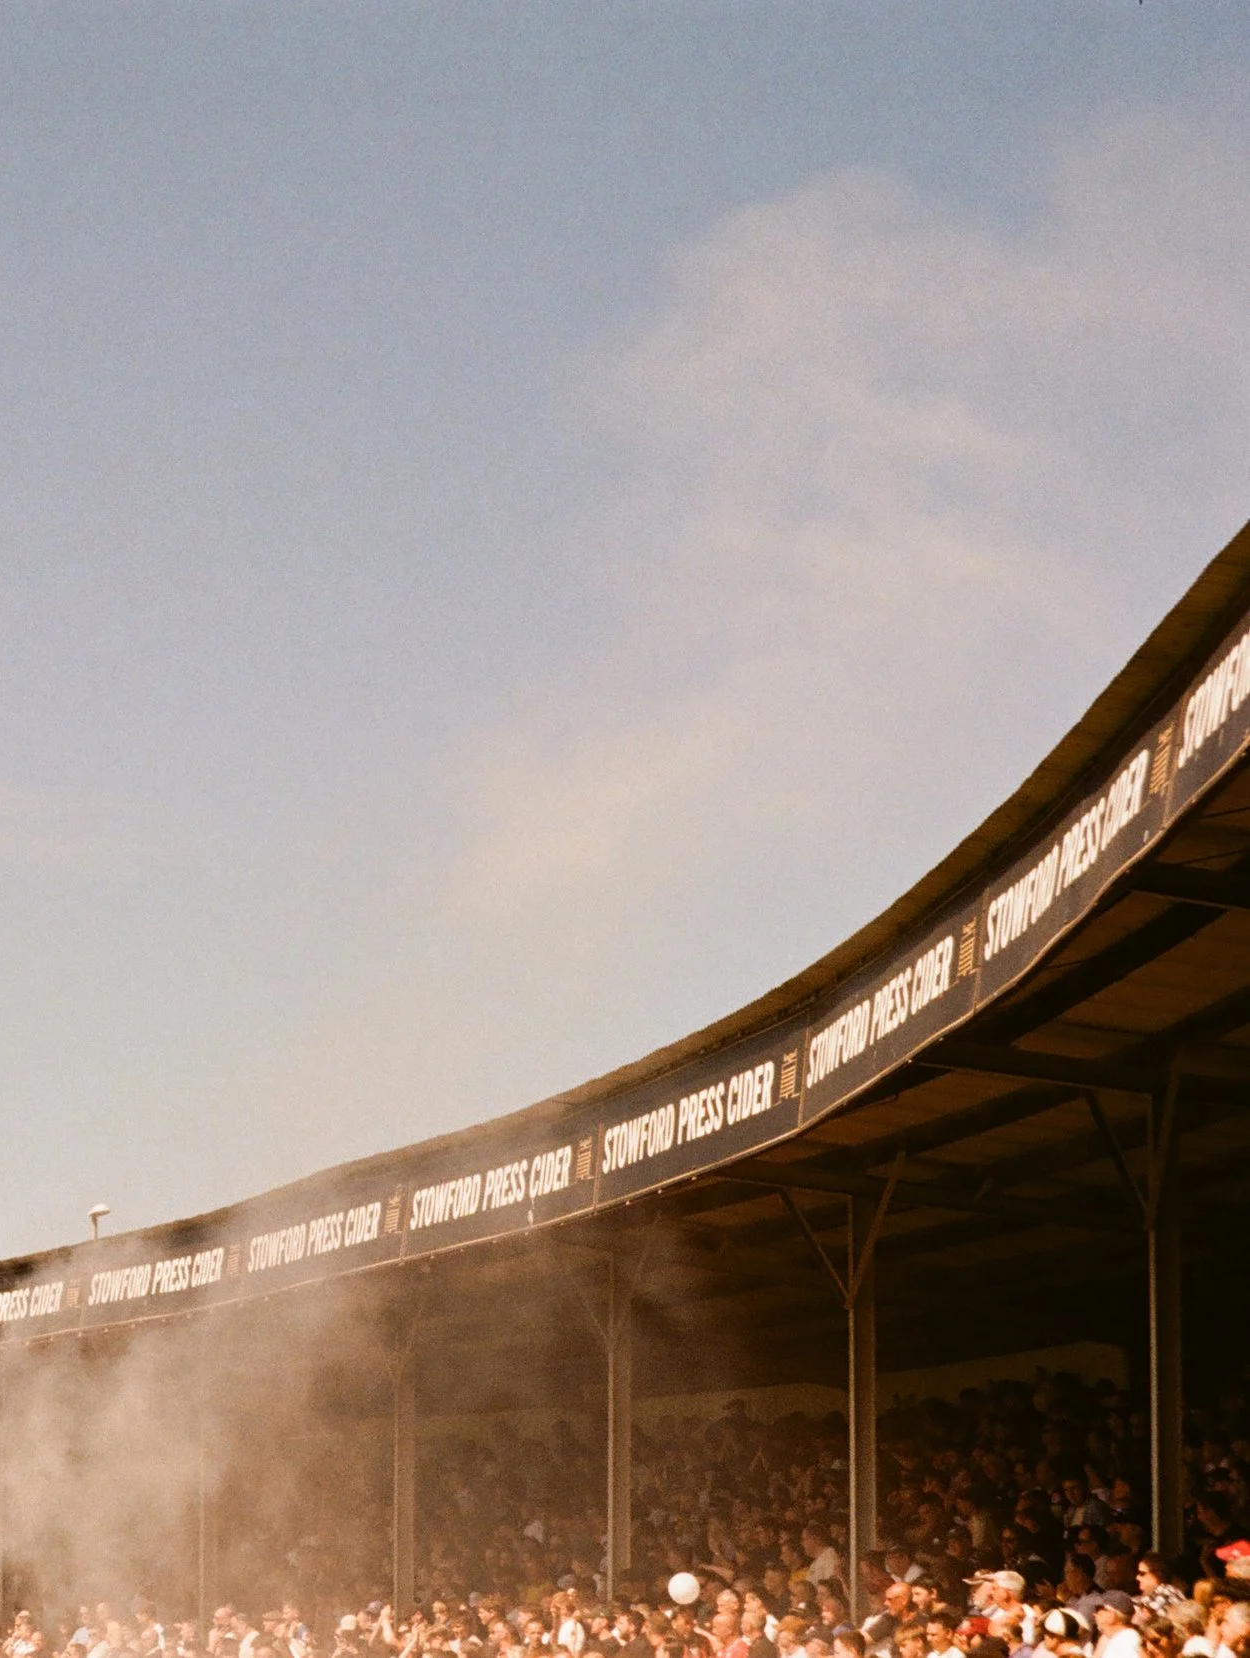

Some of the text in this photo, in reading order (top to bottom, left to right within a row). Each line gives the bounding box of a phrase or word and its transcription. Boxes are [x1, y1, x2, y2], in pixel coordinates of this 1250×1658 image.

[1178, 626, 1250, 768] STOWFO
[984, 749, 1150, 961] STOWFORD PRESS CIDER
[806, 934, 955, 1090] STOWFORD PRESS CIDER
[602, 1060, 775, 1175] STOWFORD PRESS CIDER
[247, 1202, 382, 1273] STOWFORD PRESS CIDER
[410, 1145, 573, 1231] STOWFORD PRESS CIDER
[30, 1282, 64, 1317] CIDER
[88, 1247, 224, 1306] STOWFORD PRESS CIDER
